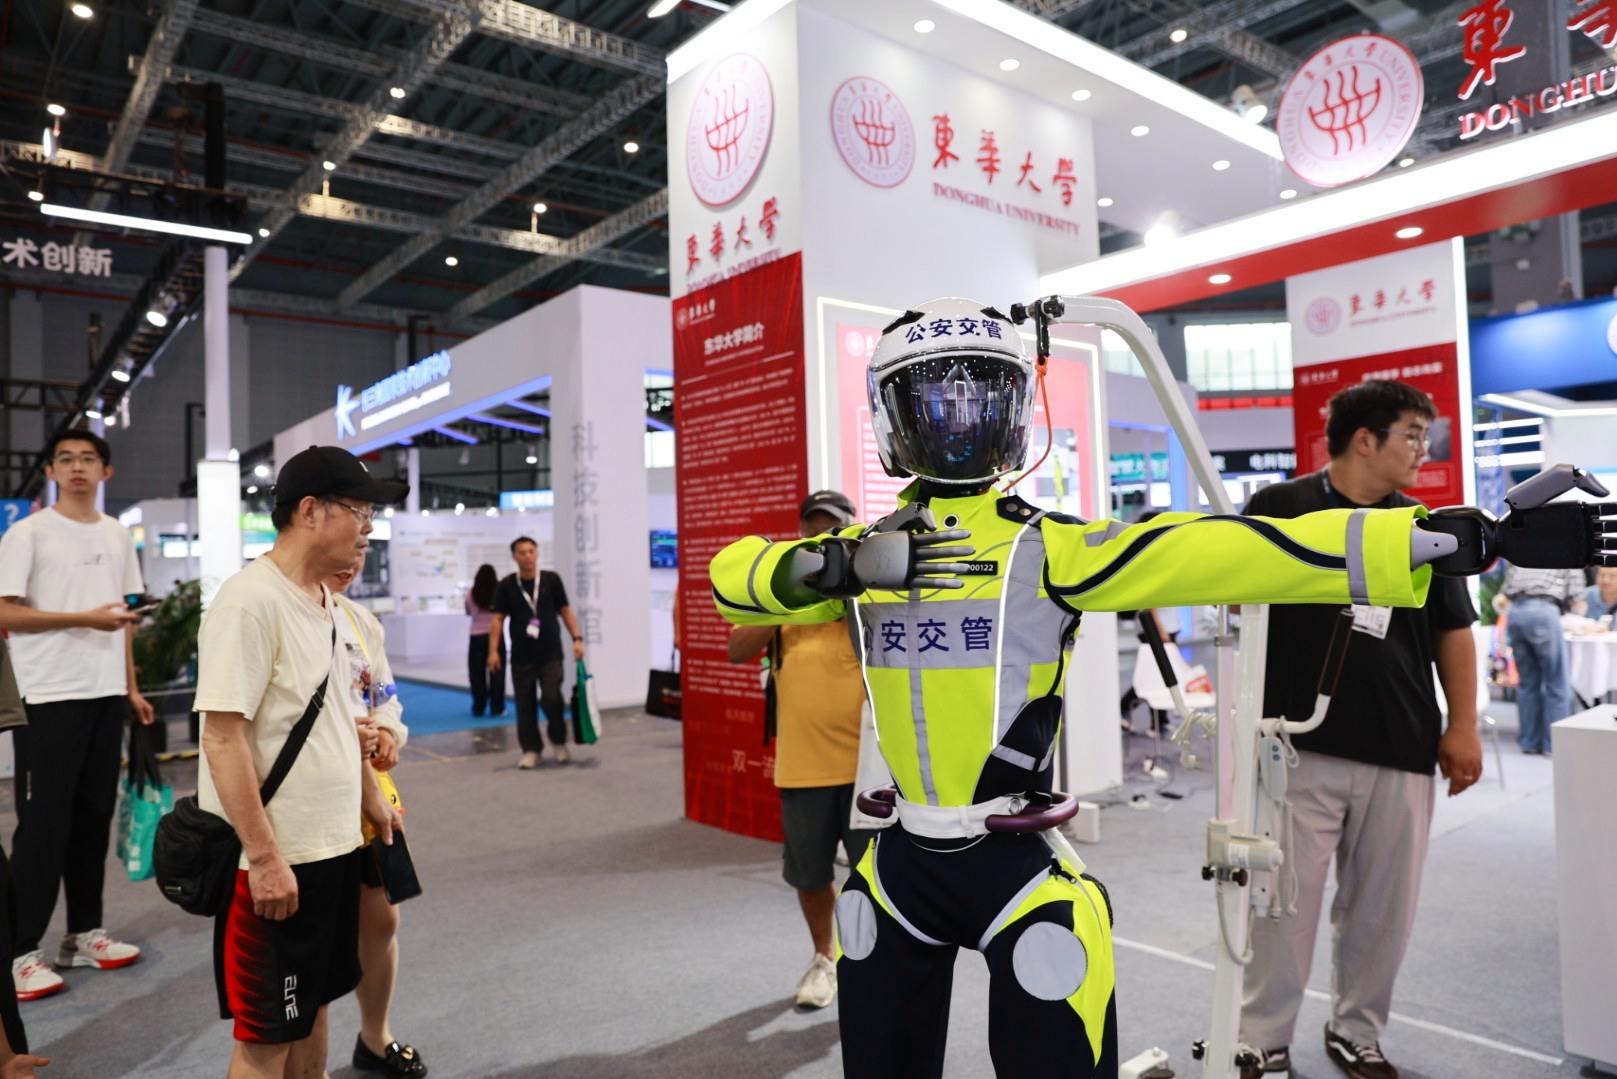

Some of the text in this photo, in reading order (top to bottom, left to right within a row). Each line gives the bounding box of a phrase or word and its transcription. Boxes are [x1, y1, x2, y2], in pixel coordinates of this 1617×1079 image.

[931, 113, 1077, 206] 東華大學
[687, 196, 779, 276] 東華大學
[933, 182, 1080, 236] DONGHUA UNIVERSITY
[2, 237, 113, 277] 术创新
[905, 317, 1002, 344] 公安交管
